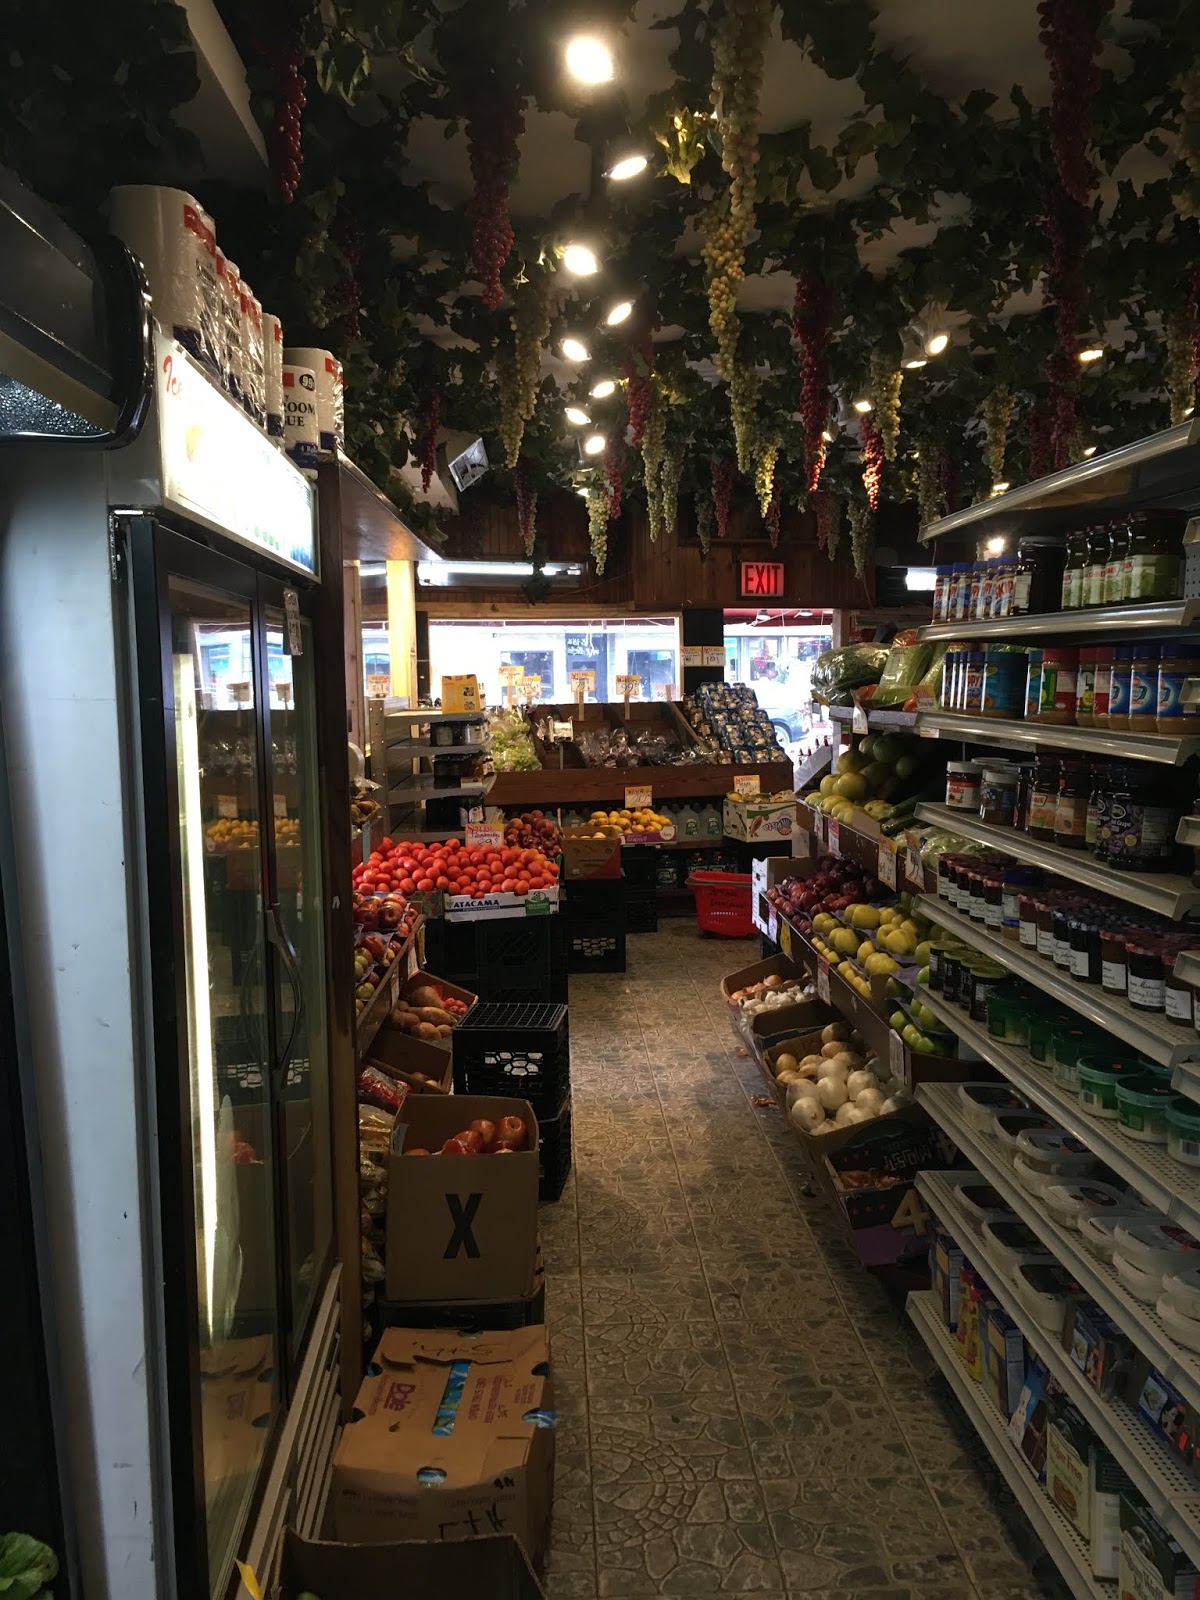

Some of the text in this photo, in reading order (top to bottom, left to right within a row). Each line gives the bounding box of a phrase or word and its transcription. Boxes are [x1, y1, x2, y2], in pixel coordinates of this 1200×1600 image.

[744, 564, 782, 595] EXIT
[453, 899, 500, 908] ATACAMA
[443, 1193, 483, 1260] X
[890, 1187, 931, 1238] 4
[386, 1381, 416, 1412] Dole
